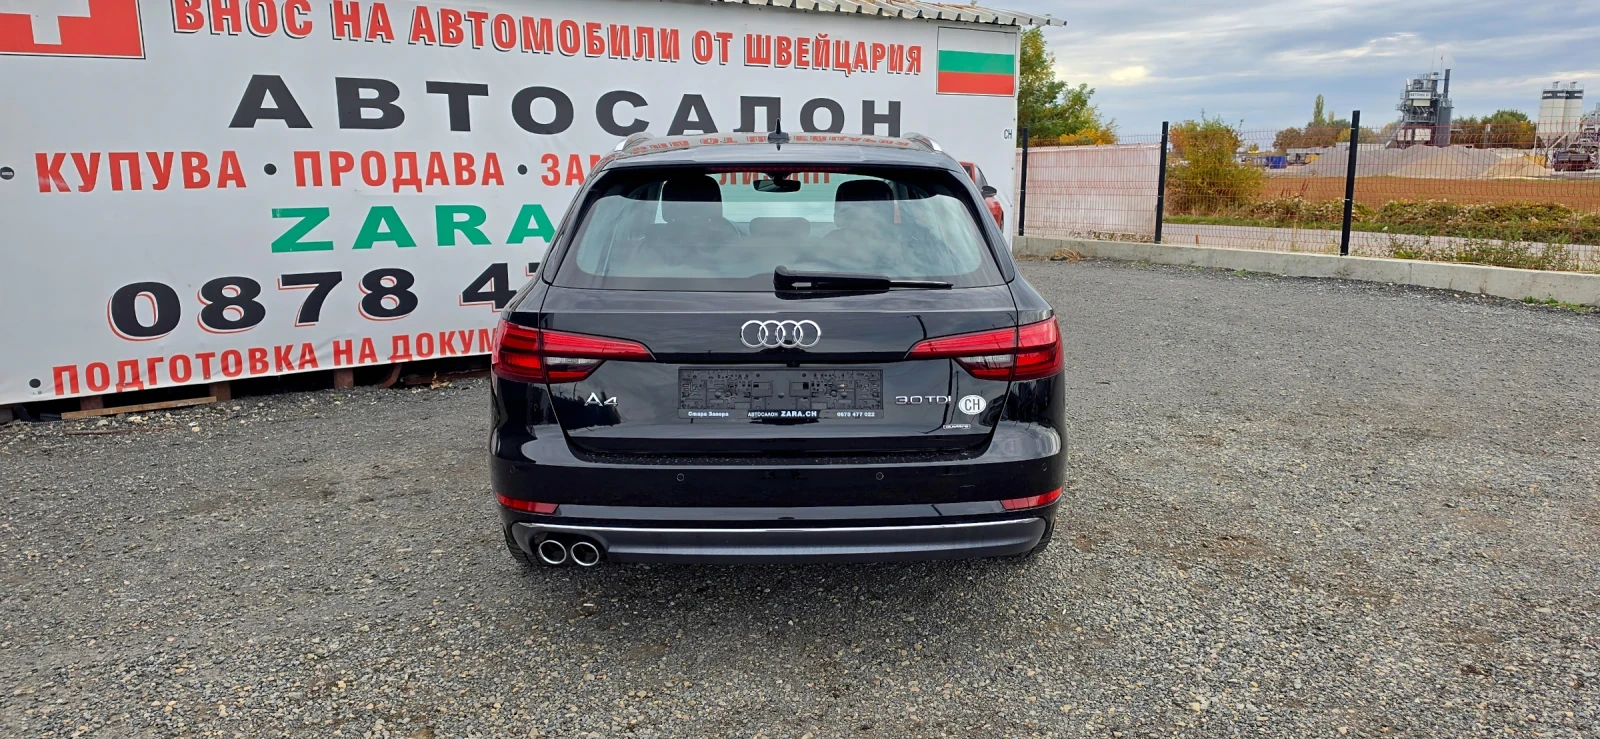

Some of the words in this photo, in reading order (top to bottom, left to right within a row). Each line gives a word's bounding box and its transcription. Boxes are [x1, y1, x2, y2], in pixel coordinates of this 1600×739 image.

[172, 0, 313, 39] ВНОС
[331, 0, 395, 43] НА
[409, 4, 680, 62] АВТОМОБИЛИ
[692, 30, 733, 66] ОТ
[743, 34, 922, 76] ШВЕЙЦАРИЯ
[228, 74, 902, 136] АВТОСАЛОН
[35, 151, 247, 193] КУПУВА
[293, 150, 505, 193] ПРОДАВА
[107, 267, 419, 342] 0878
[459, 262, 541, 313] 4
[52, 341, 319, 396] ПОДГОТОВКА
[333, 338, 379, 367] НА
[964, 398, 981, 412] CH
